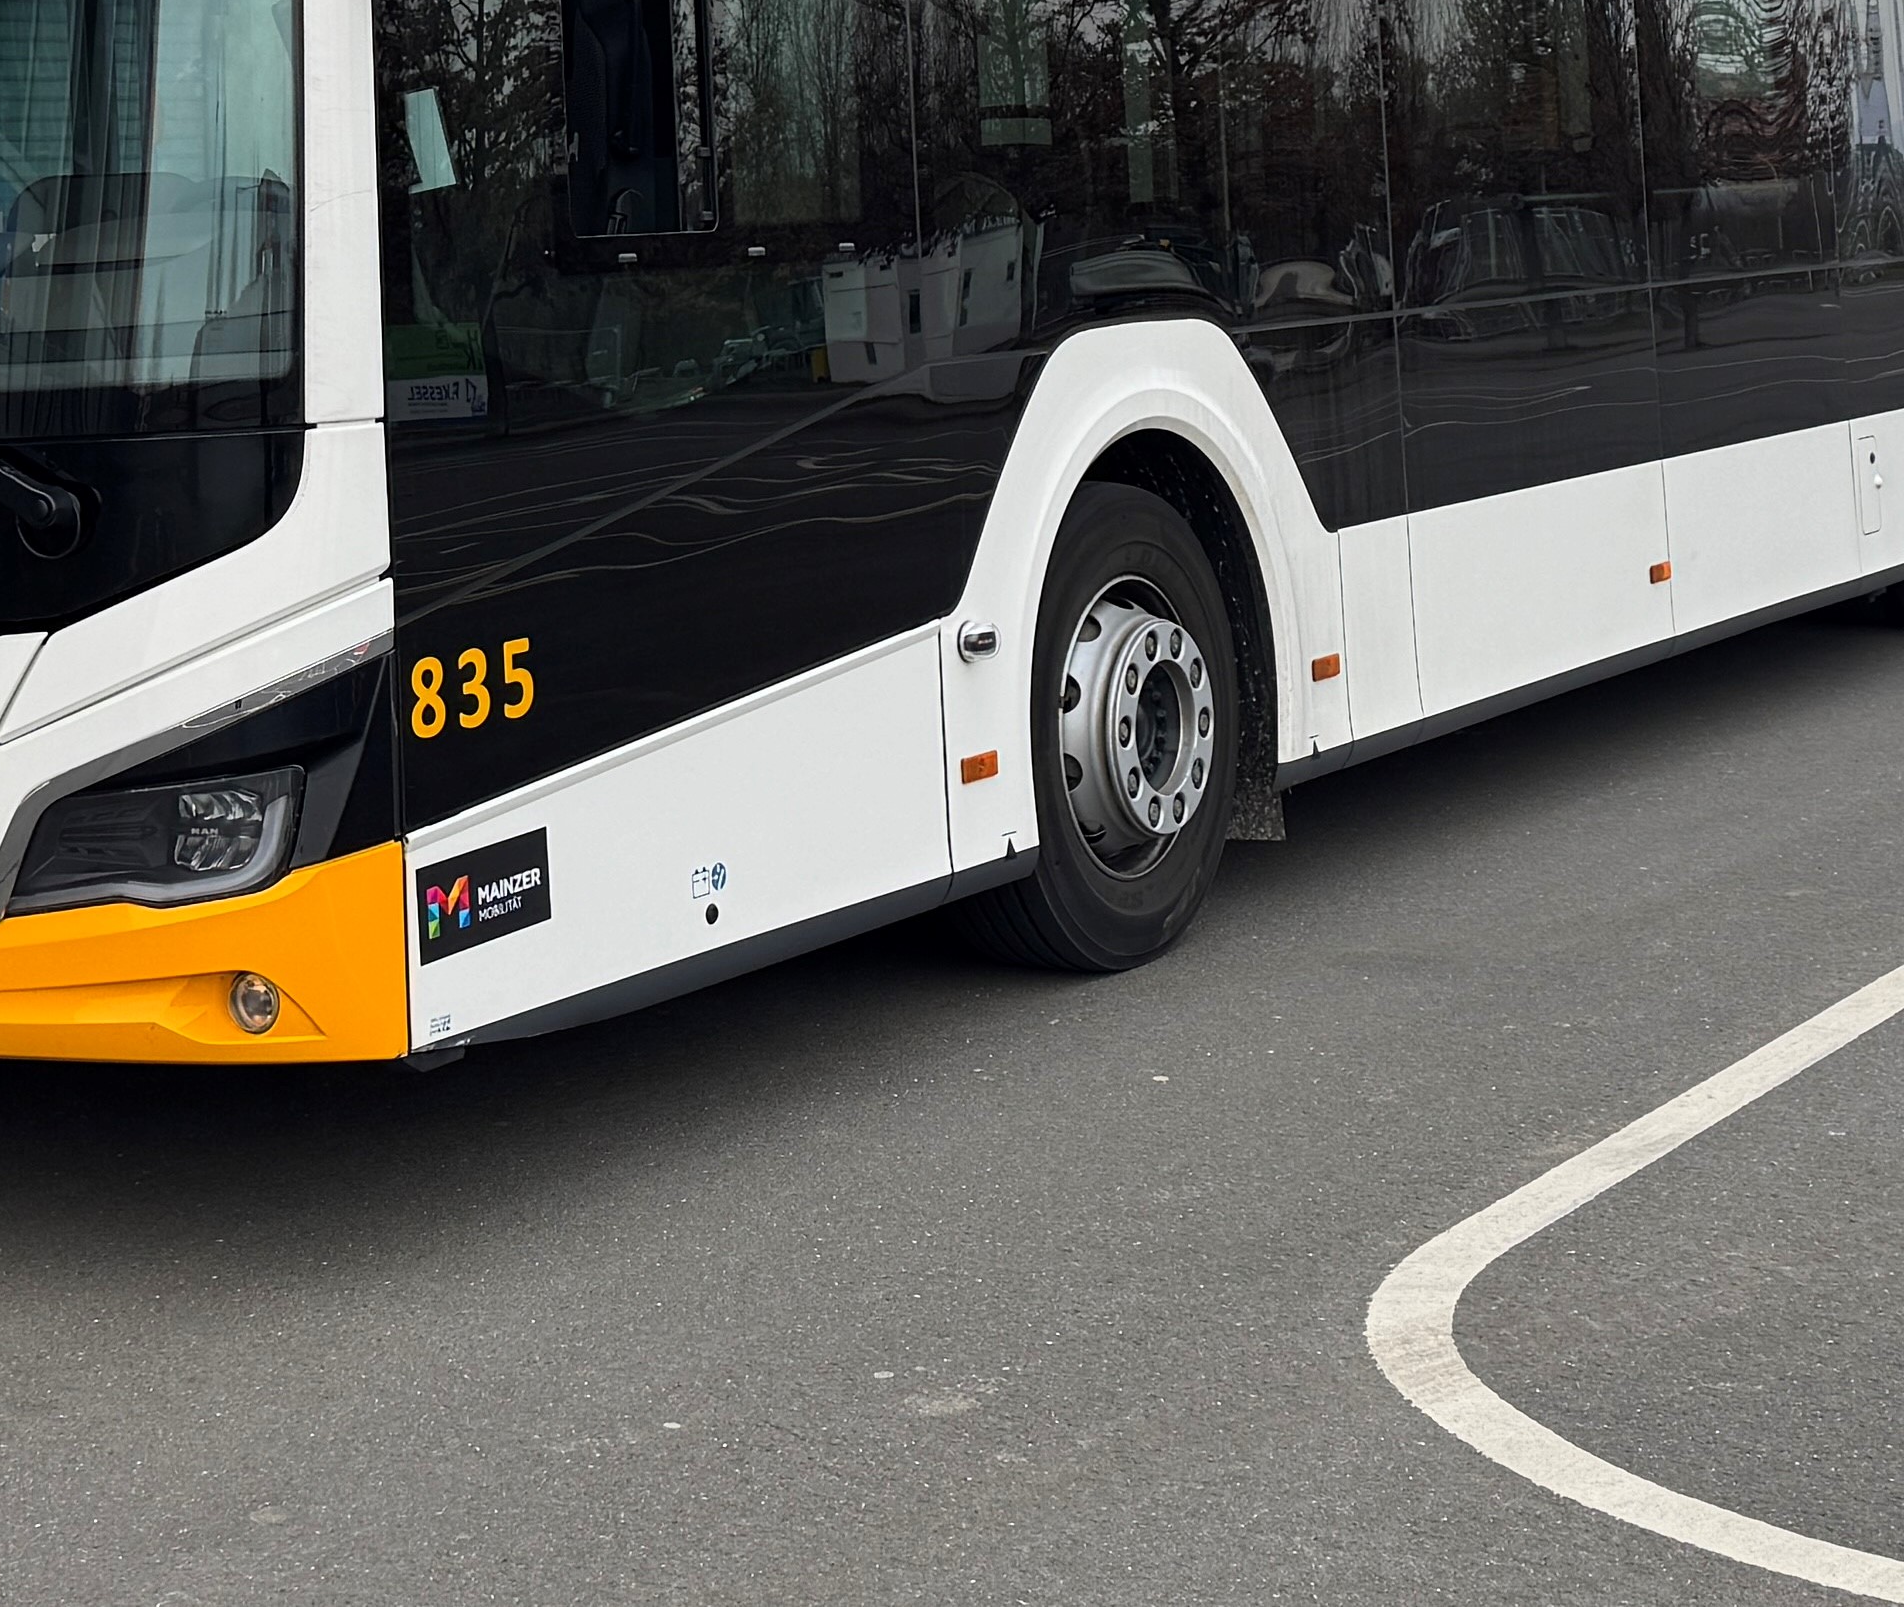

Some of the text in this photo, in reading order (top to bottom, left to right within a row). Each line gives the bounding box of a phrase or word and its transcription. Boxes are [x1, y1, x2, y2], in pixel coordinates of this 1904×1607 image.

[410, 637, 535, 739] 835
[477, 867, 542, 906] MAINZER
[478, 895, 523, 922] MOBILITÄT
